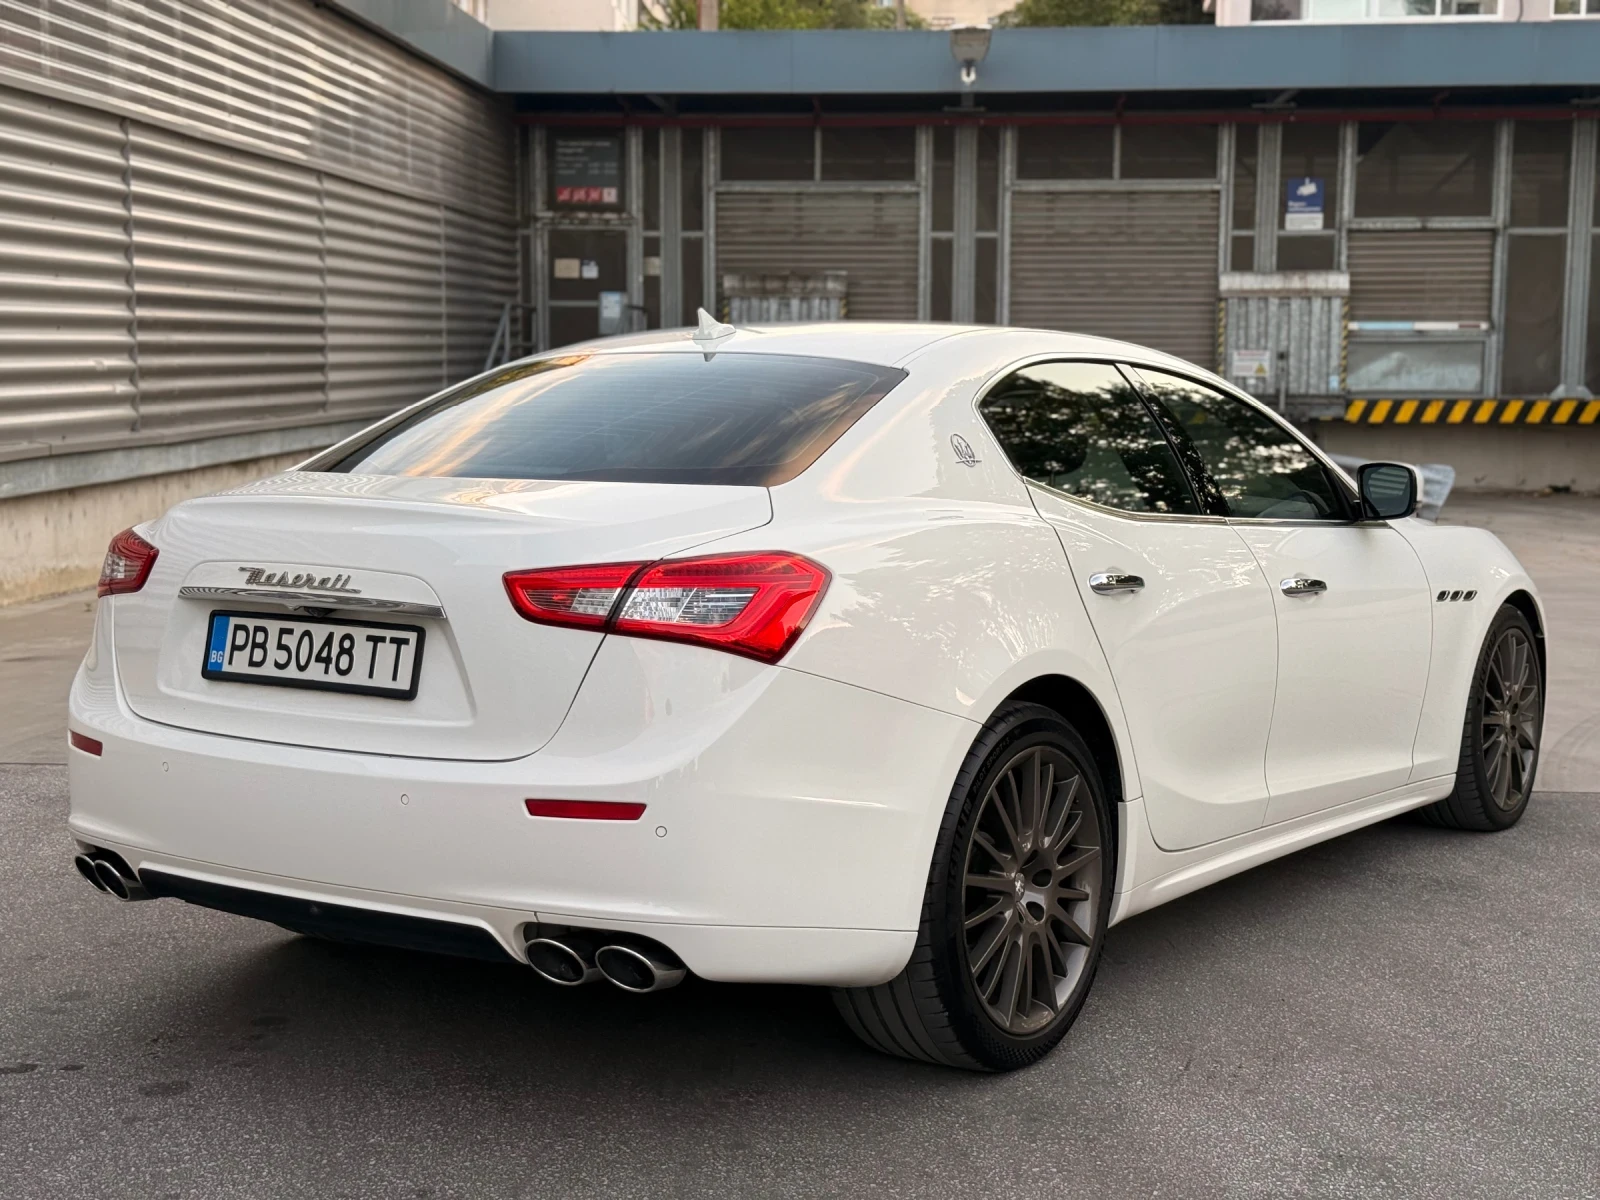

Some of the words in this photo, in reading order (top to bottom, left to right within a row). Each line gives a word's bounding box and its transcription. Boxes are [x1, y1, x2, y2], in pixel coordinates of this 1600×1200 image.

[238, 566, 362, 594] Maserati
[210, 650, 224, 663] BG
[228, 623, 270, 668] PB
[273, 627, 356, 676] 5048
[365, 634, 411, 681] TT
[972, 767, 987, 793] PILOT
[987, 743, 1004, 769] SPORT
